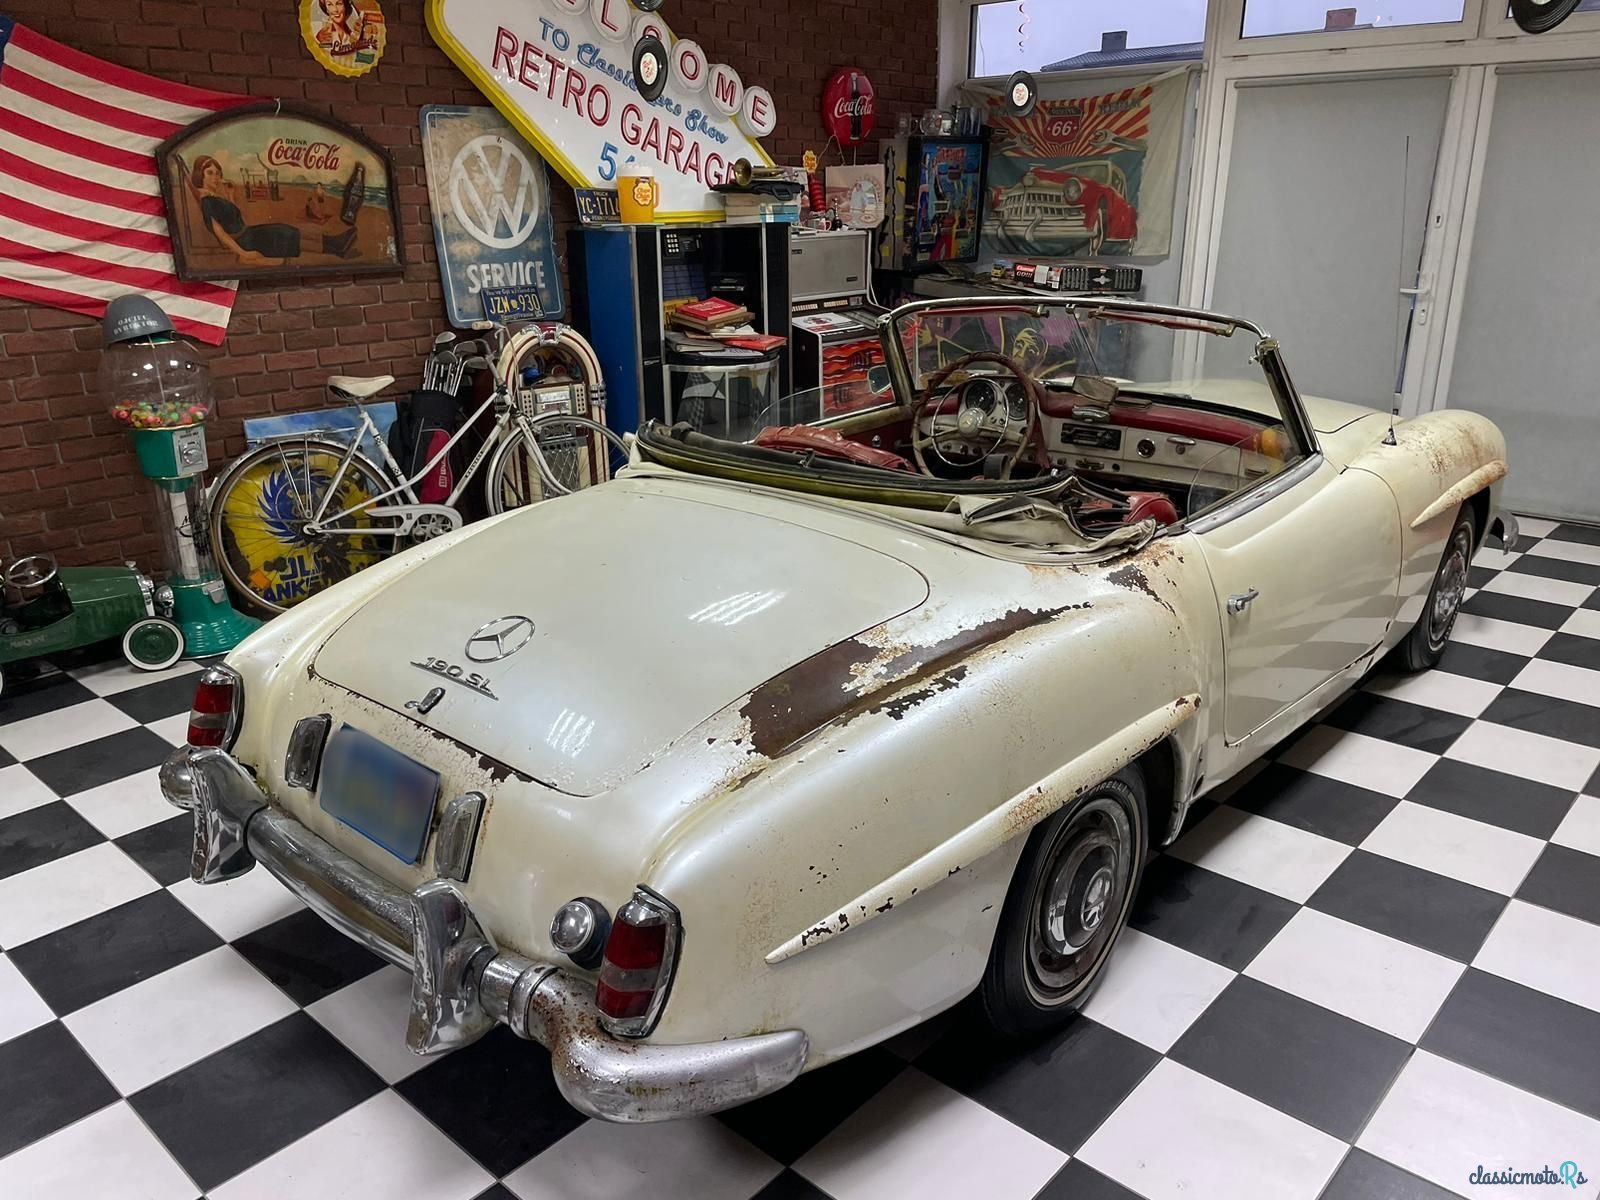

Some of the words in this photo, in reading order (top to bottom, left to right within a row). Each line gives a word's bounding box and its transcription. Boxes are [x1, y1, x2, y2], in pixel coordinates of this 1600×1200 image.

[491, 26, 612, 127] RETRO
[539, 17, 570, 51] TO
[649, 94, 682, 117] ars
[685, 108, 728, 144] Show
[834, 95, 873, 118] Coca-Cola
[285, 138, 308, 146] DRINK
[1051, 121, 1073, 136] 66
[268, 138, 341, 171] Coca-Cola
[466, 260, 546, 294] SERVICE
[490, 295, 511, 315] JZW
[518, 293, 541, 312] 930
[424, 657, 464, 678] 190
[465, 672, 491, 692] SL
